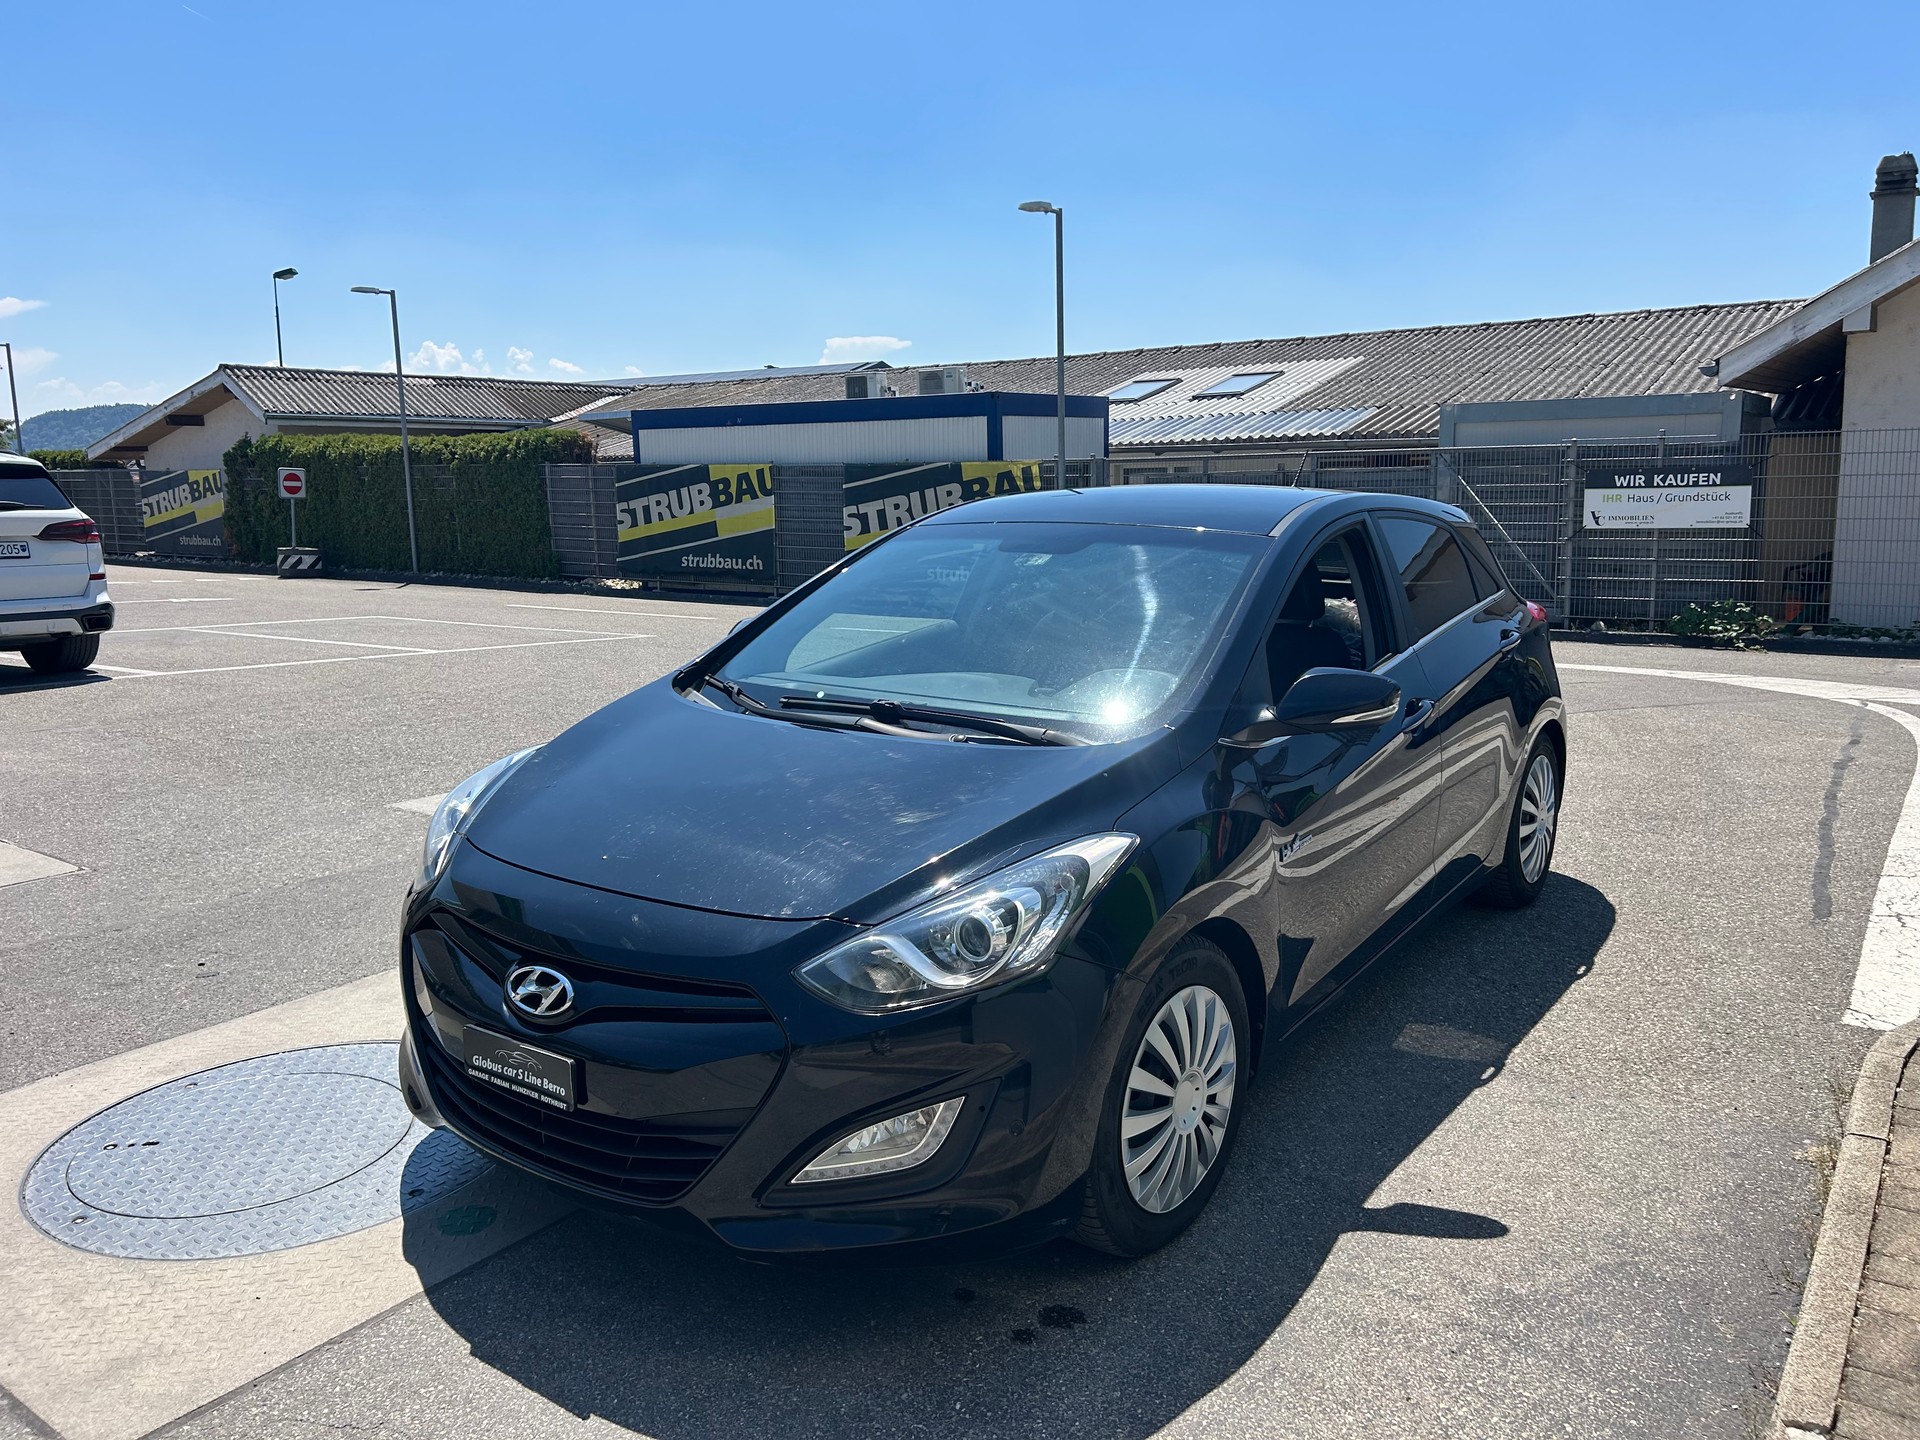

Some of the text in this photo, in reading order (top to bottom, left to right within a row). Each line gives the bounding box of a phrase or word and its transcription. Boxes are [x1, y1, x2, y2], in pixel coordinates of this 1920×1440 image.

[1614, 472, 1722, 487] WIR KAUFEN
[141, 471, 223, 519] STRUBBAU
[616, 467, 774, 531] STRUBBAU
[843, 462, 1044, 538] STRUBBAU
[1602, 493, 1623, 503] IHR
[1627, 493, 1655, 503] Haus
[1664, 491, 1731, 503] Grundstück
[179, 534, 222, 546] strubbau.ch
[681, 552, 764, 571] strubbau.ch
[926, 565, 970, 582] strub
[468, 1068, 489, 1081] GARAGE
[490, 1076, 510, 1089] FABIAN
[540, 1095, 567, 1111] ROTHRIST
[472, 1055, 566, 1096] Globus car S Line Berro
